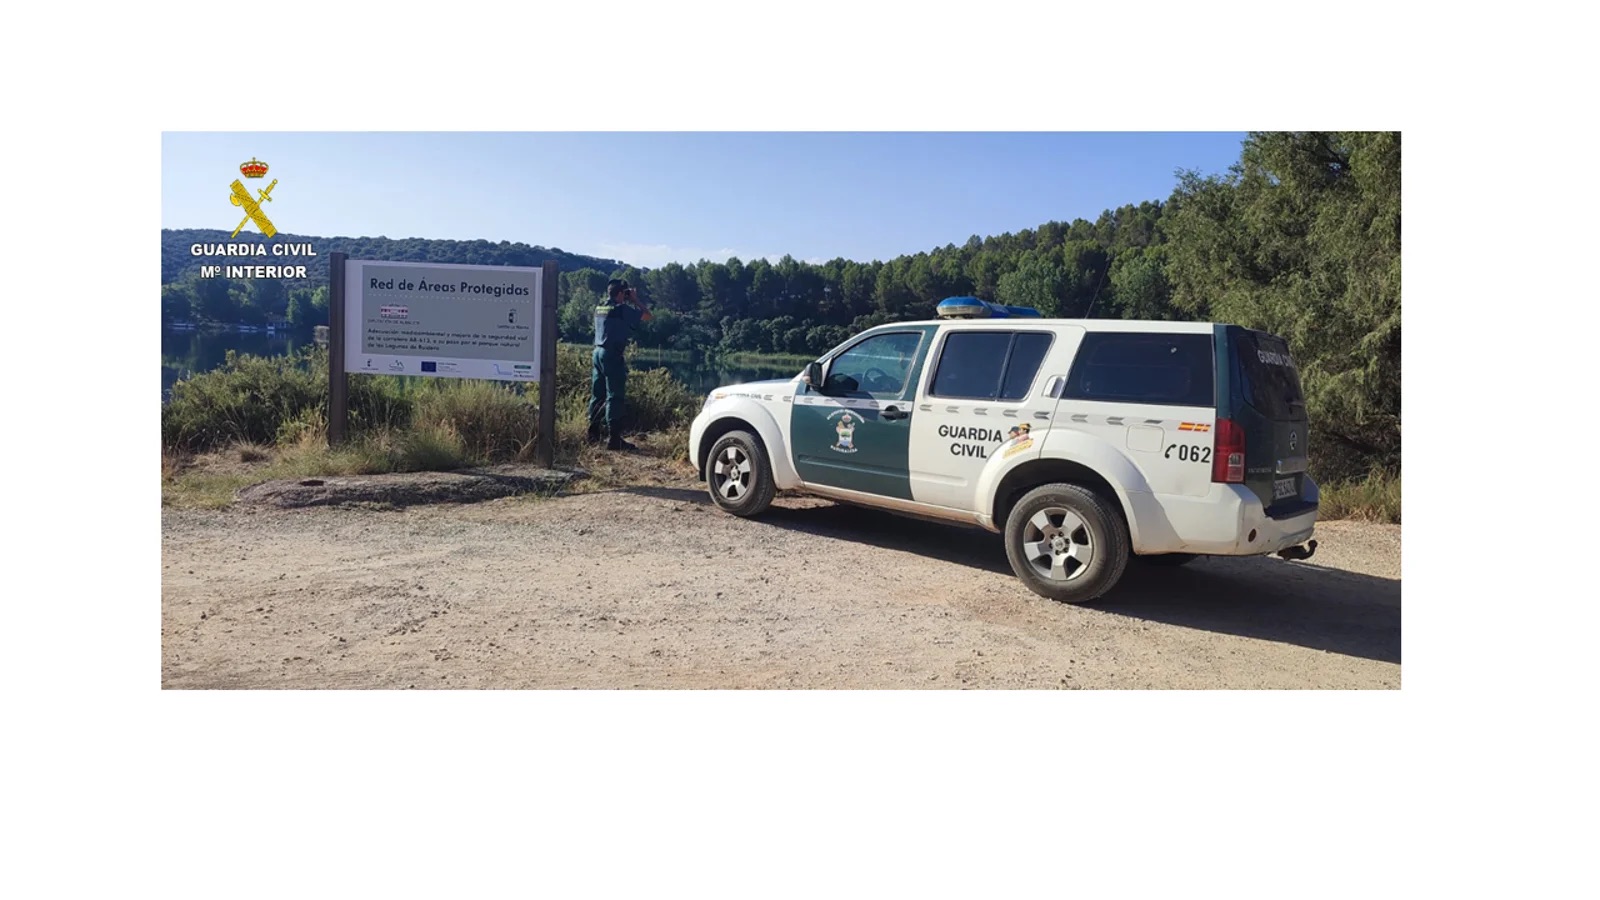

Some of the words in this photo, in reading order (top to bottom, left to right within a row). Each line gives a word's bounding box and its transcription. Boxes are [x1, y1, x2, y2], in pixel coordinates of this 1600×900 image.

[370, 278, 394, 290] Red
[398, 278, 415, 291] de
[418, 276, 456, 293] Áreas
[460, 281, 530, 298] Protegidas
[1256, 349, 1283, 366] GUARDIA
[937, 424, 1003, 443] GUARDIA
[949, 442, 988, 460] CIVIL
[1177, 443, 1212, 464] 062
